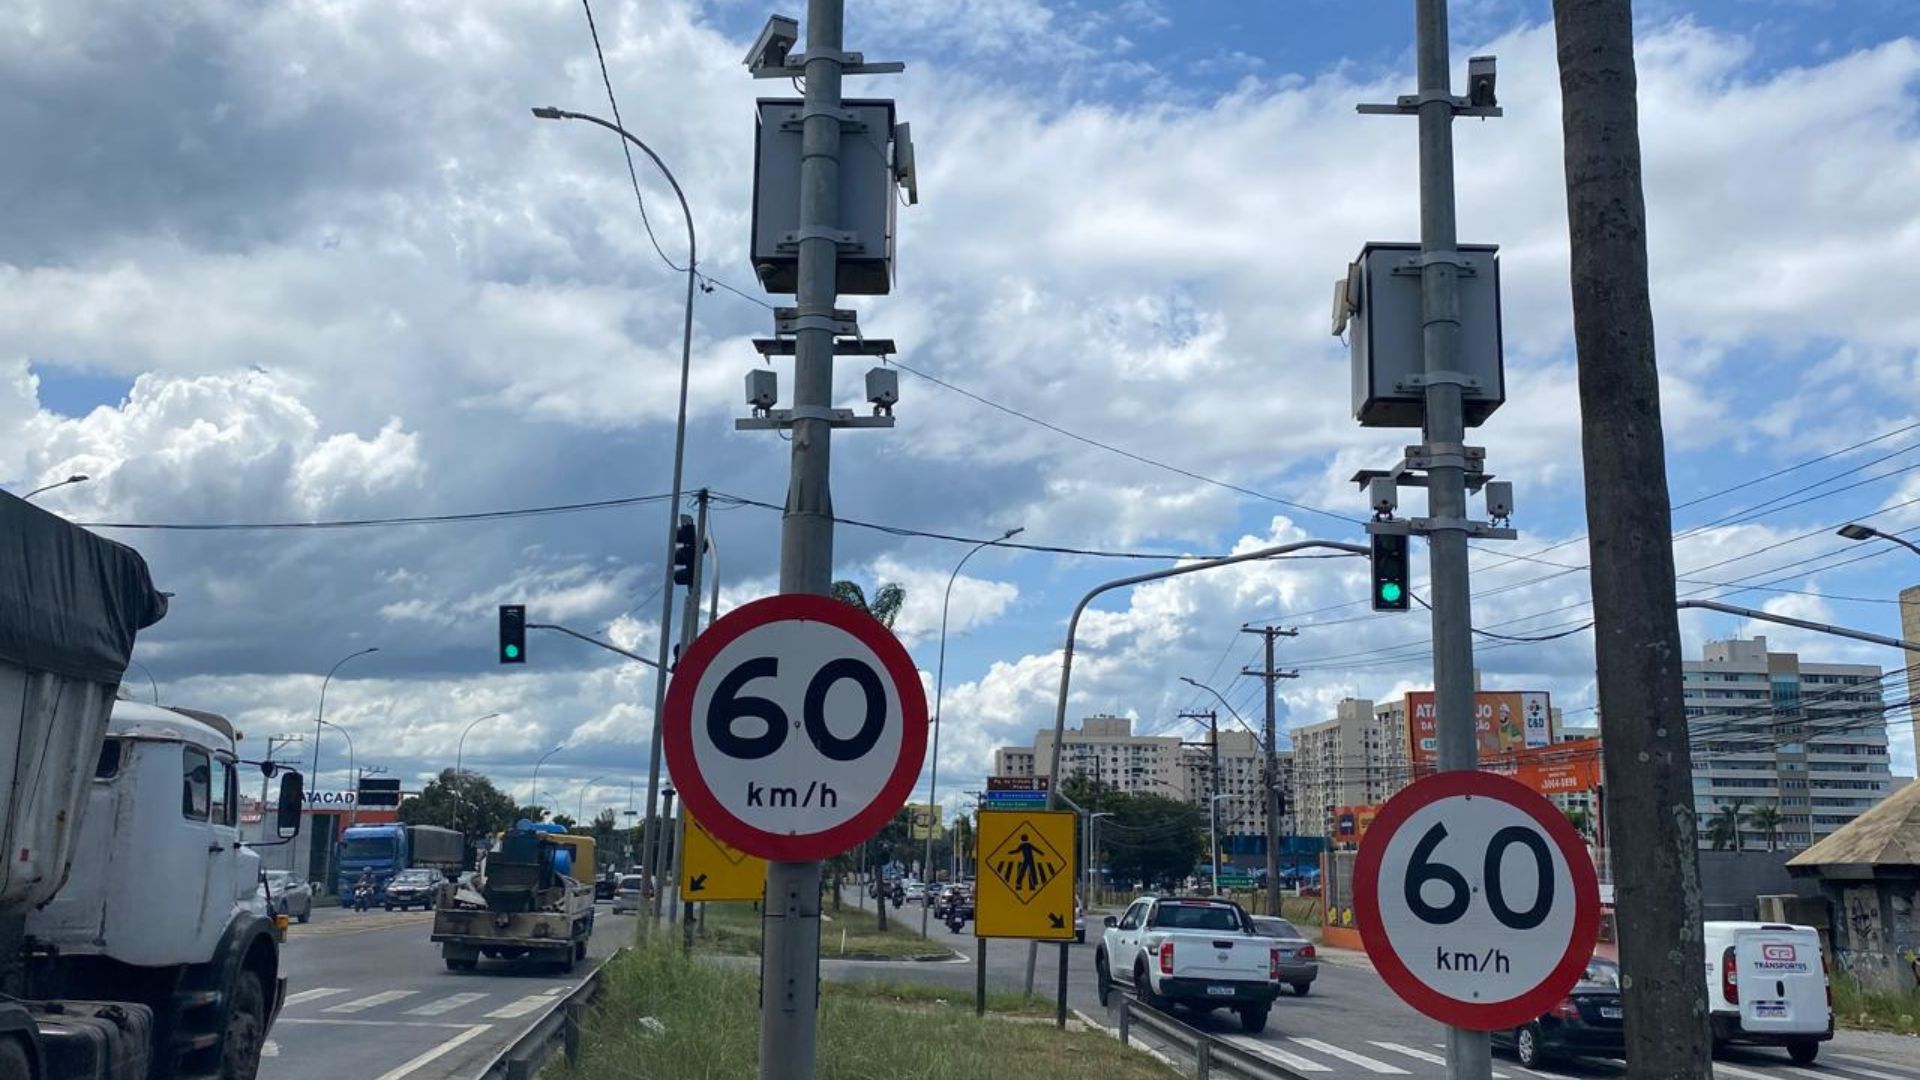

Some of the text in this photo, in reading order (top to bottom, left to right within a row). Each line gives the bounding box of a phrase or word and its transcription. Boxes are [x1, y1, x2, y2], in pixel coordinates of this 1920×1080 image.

[707, 656, 887, 761] 60
[747, 781, 838, 808] km/h
[1404, 821, 1555, 930] 60
[1437, 946, 1510, 974] km/h
